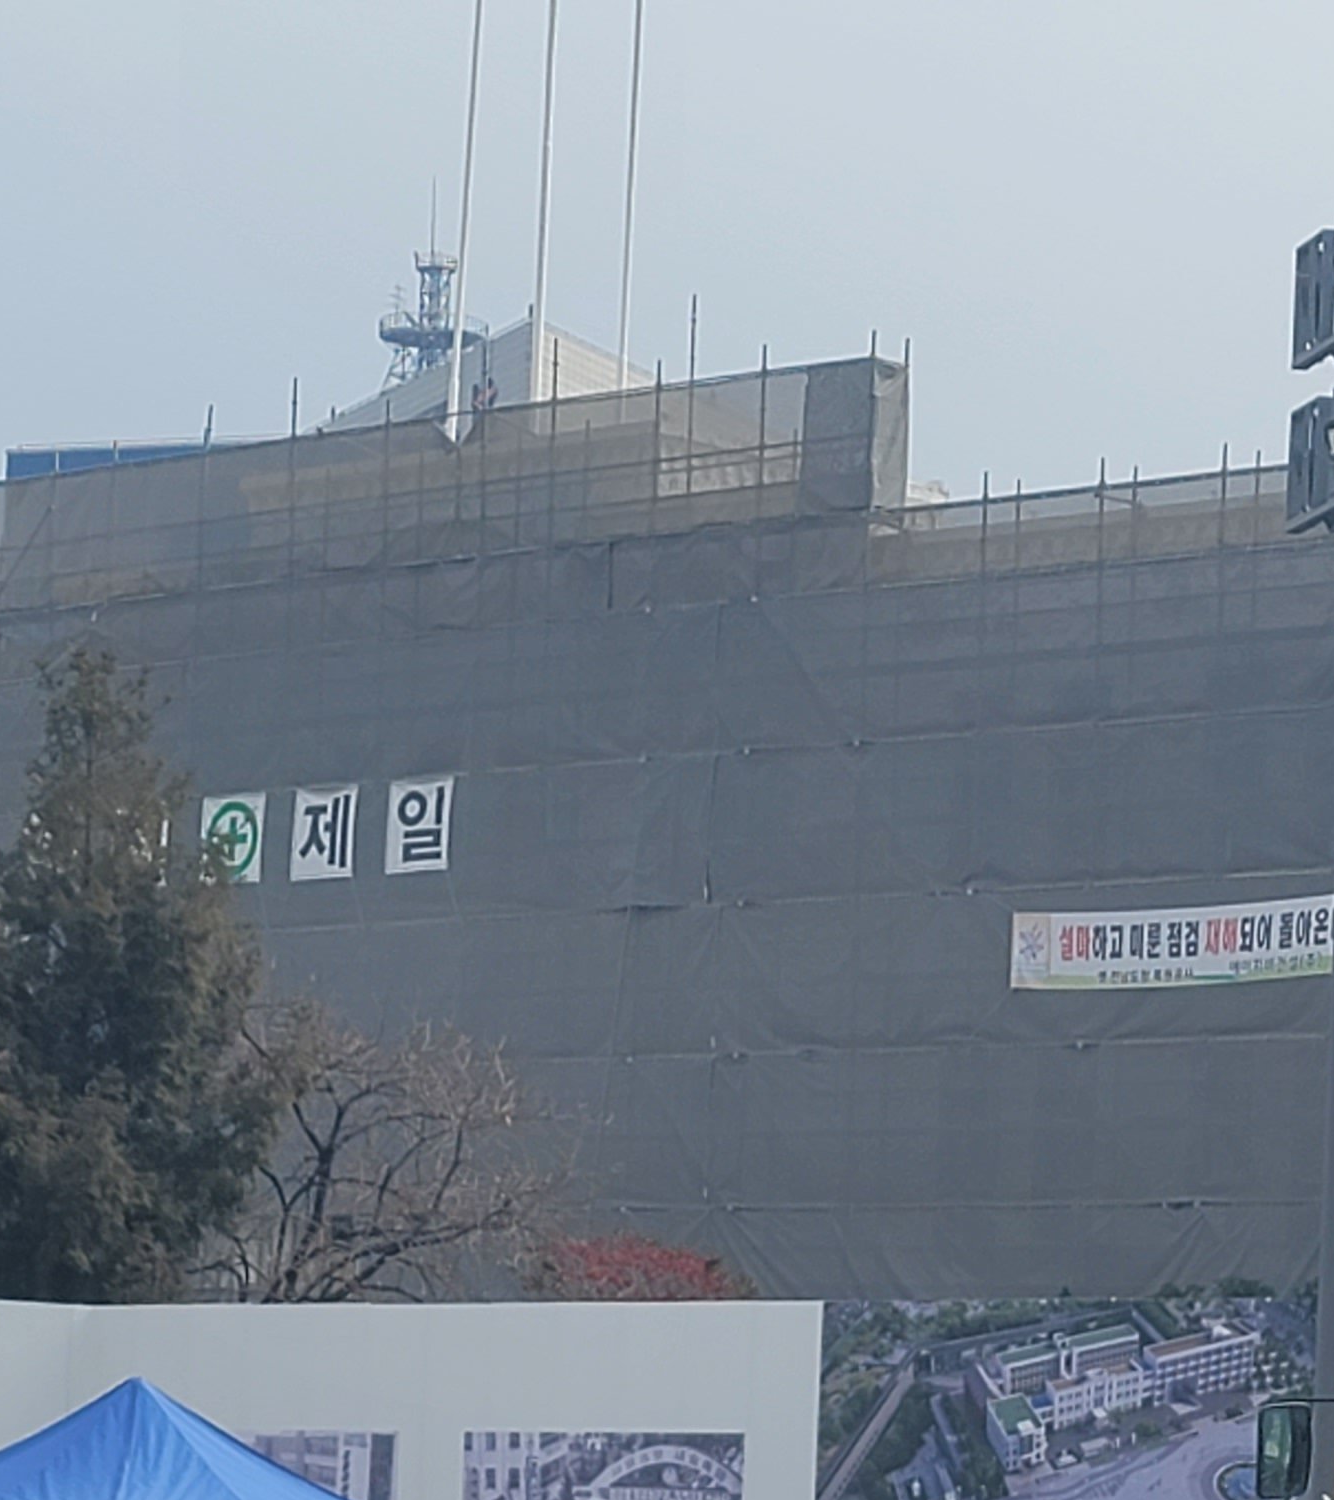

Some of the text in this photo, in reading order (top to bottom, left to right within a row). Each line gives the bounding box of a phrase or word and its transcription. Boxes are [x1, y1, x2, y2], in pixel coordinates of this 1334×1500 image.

[1130, 922, 1162, 960] 미룬
[1167, 919, 1199, 958] 점검
[1279, 907, 1334, 950] 돌아온
